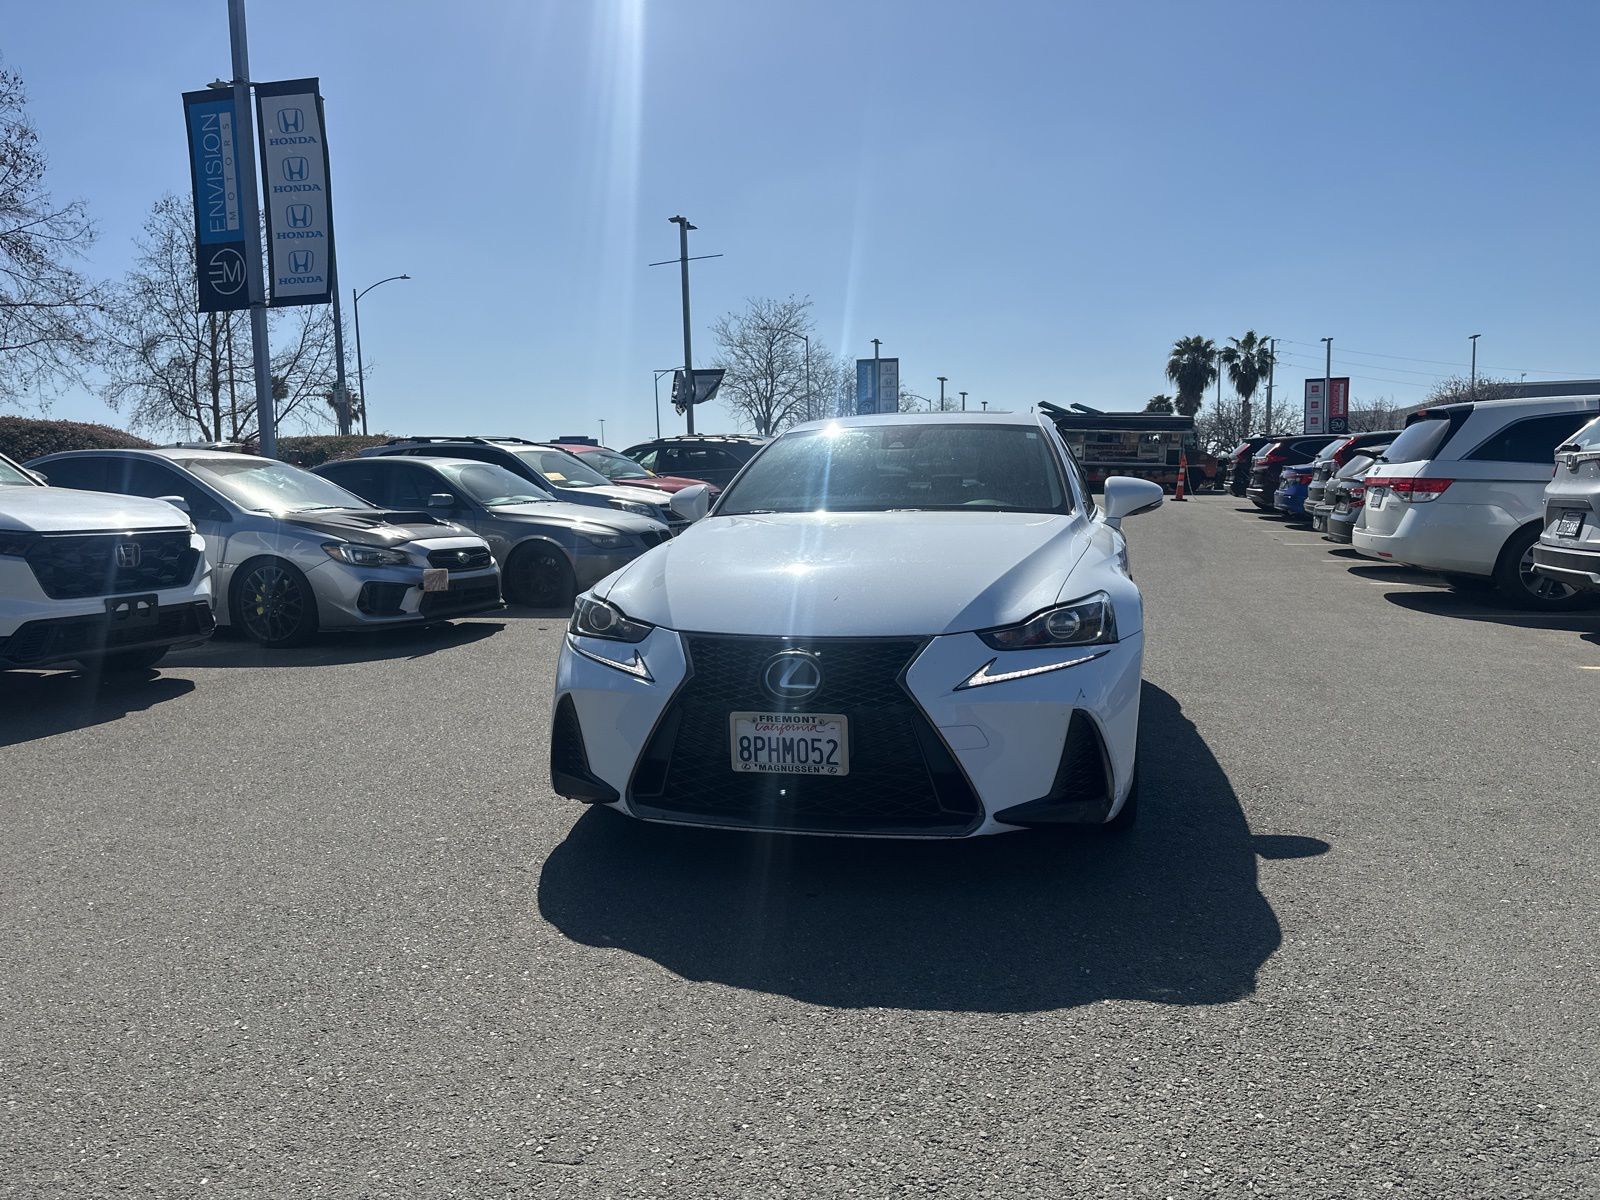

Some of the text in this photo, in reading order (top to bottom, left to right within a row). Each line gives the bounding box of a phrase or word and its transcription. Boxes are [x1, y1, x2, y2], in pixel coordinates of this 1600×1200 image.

[269, 136, 318, 146] HONDA
[201, 113, 226, 232] ENVISION
[223, 123, 238, 220] MOTORS
[273, 184, 322, 194] HONDA
[276, 230, 324, 240] HONDA
[278, 275, 323, 285] HONDA
[759, 715, 817, 724] FREMONT
[755, 723, 825, 735] California
[739, 736, 840, 766] 8PHM052
[758, 764, 821, 773] MAGNUSSEN
